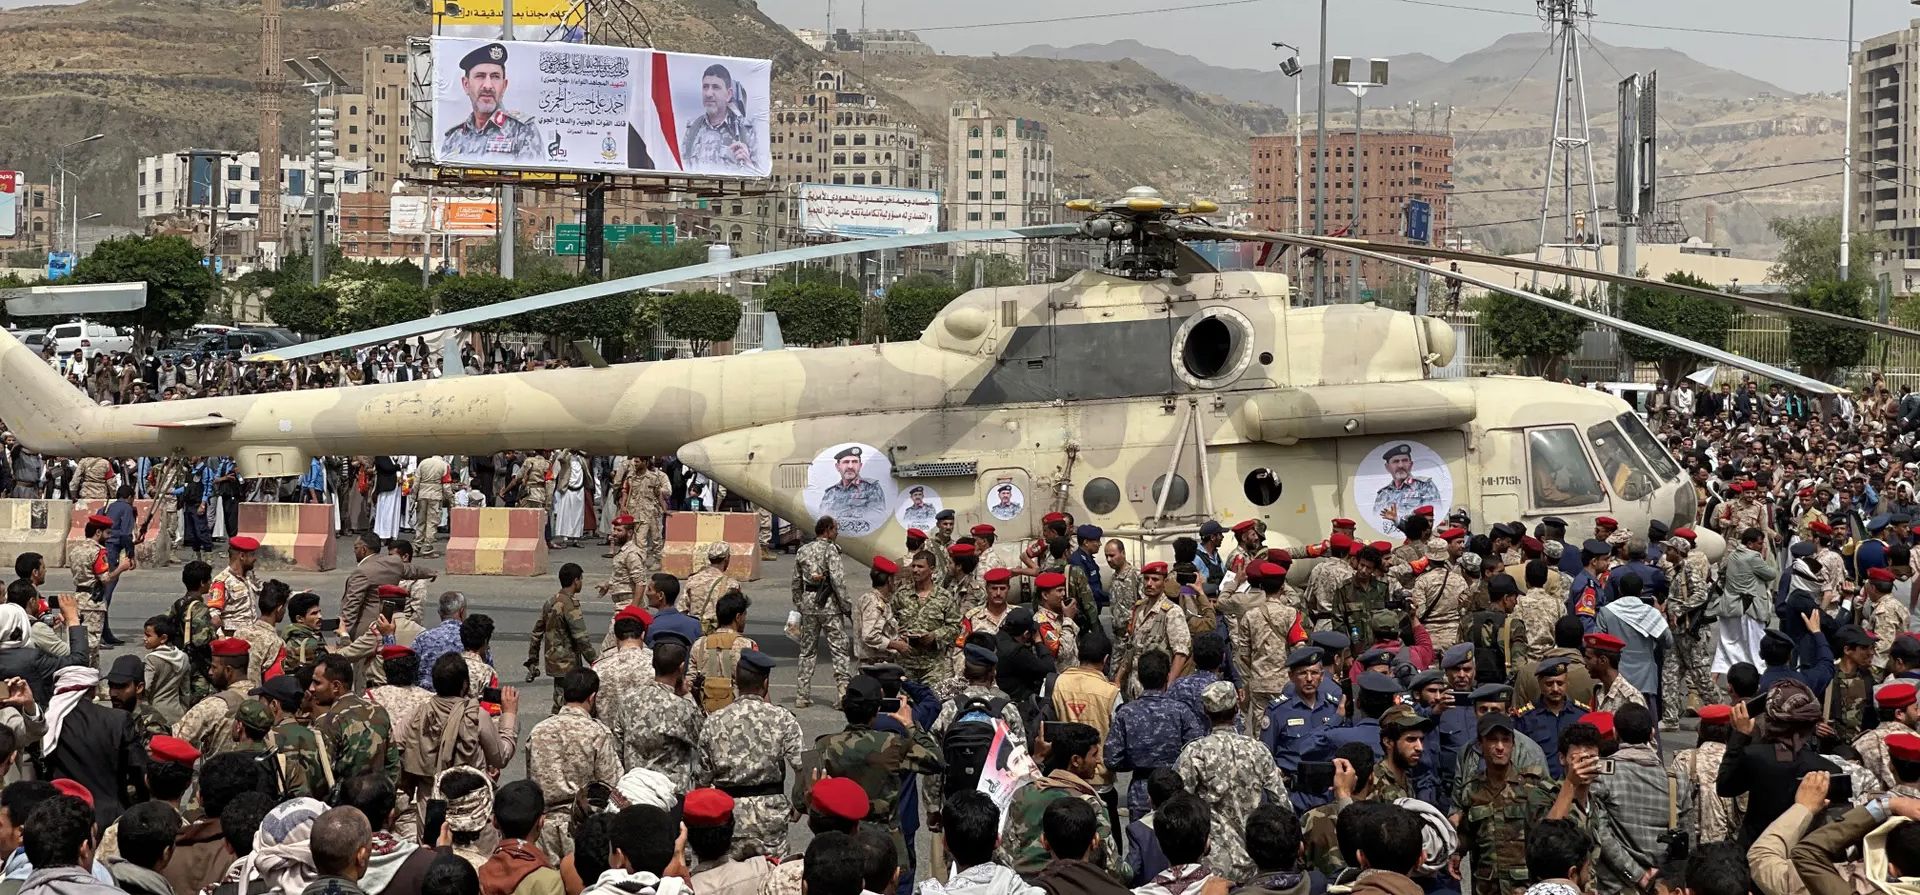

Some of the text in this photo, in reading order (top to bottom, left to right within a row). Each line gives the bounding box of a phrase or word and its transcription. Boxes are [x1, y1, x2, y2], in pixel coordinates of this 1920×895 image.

[474, 9, 503, 19] لدقيقة
[555, 116, 576, 126] والدفاع
[576, 117, 595, 127] الجوية
[595, 118, 613, 128] القوات
[613, 119, 627, 128] قائد
